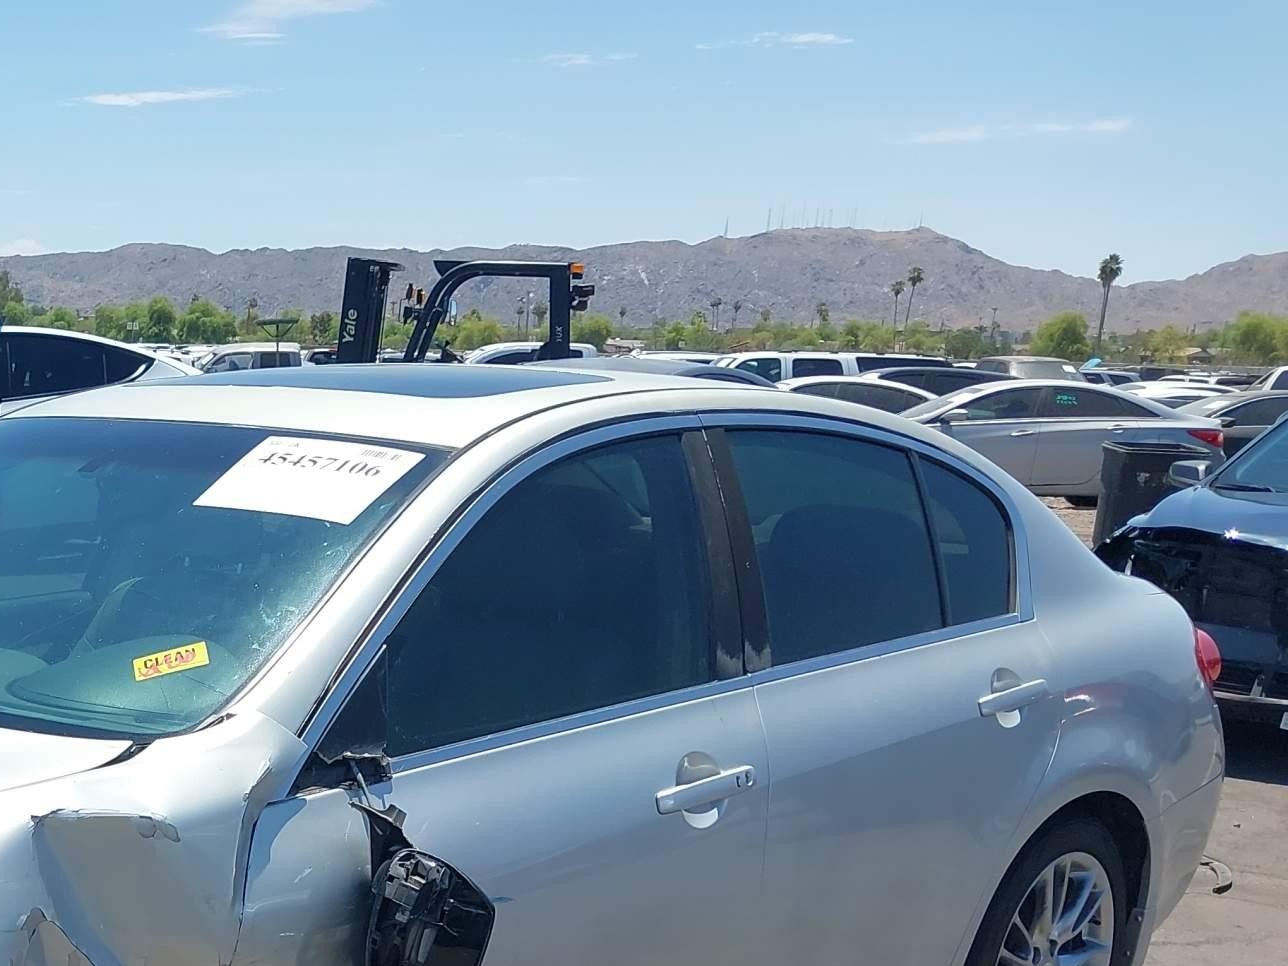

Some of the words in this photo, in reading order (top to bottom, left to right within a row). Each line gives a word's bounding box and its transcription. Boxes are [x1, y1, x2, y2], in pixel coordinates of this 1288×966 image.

[342, 309, 358, 342] Yale
[259, 452, 381, 477] 45457106
[144, 647, 196, 669] CLEAN
